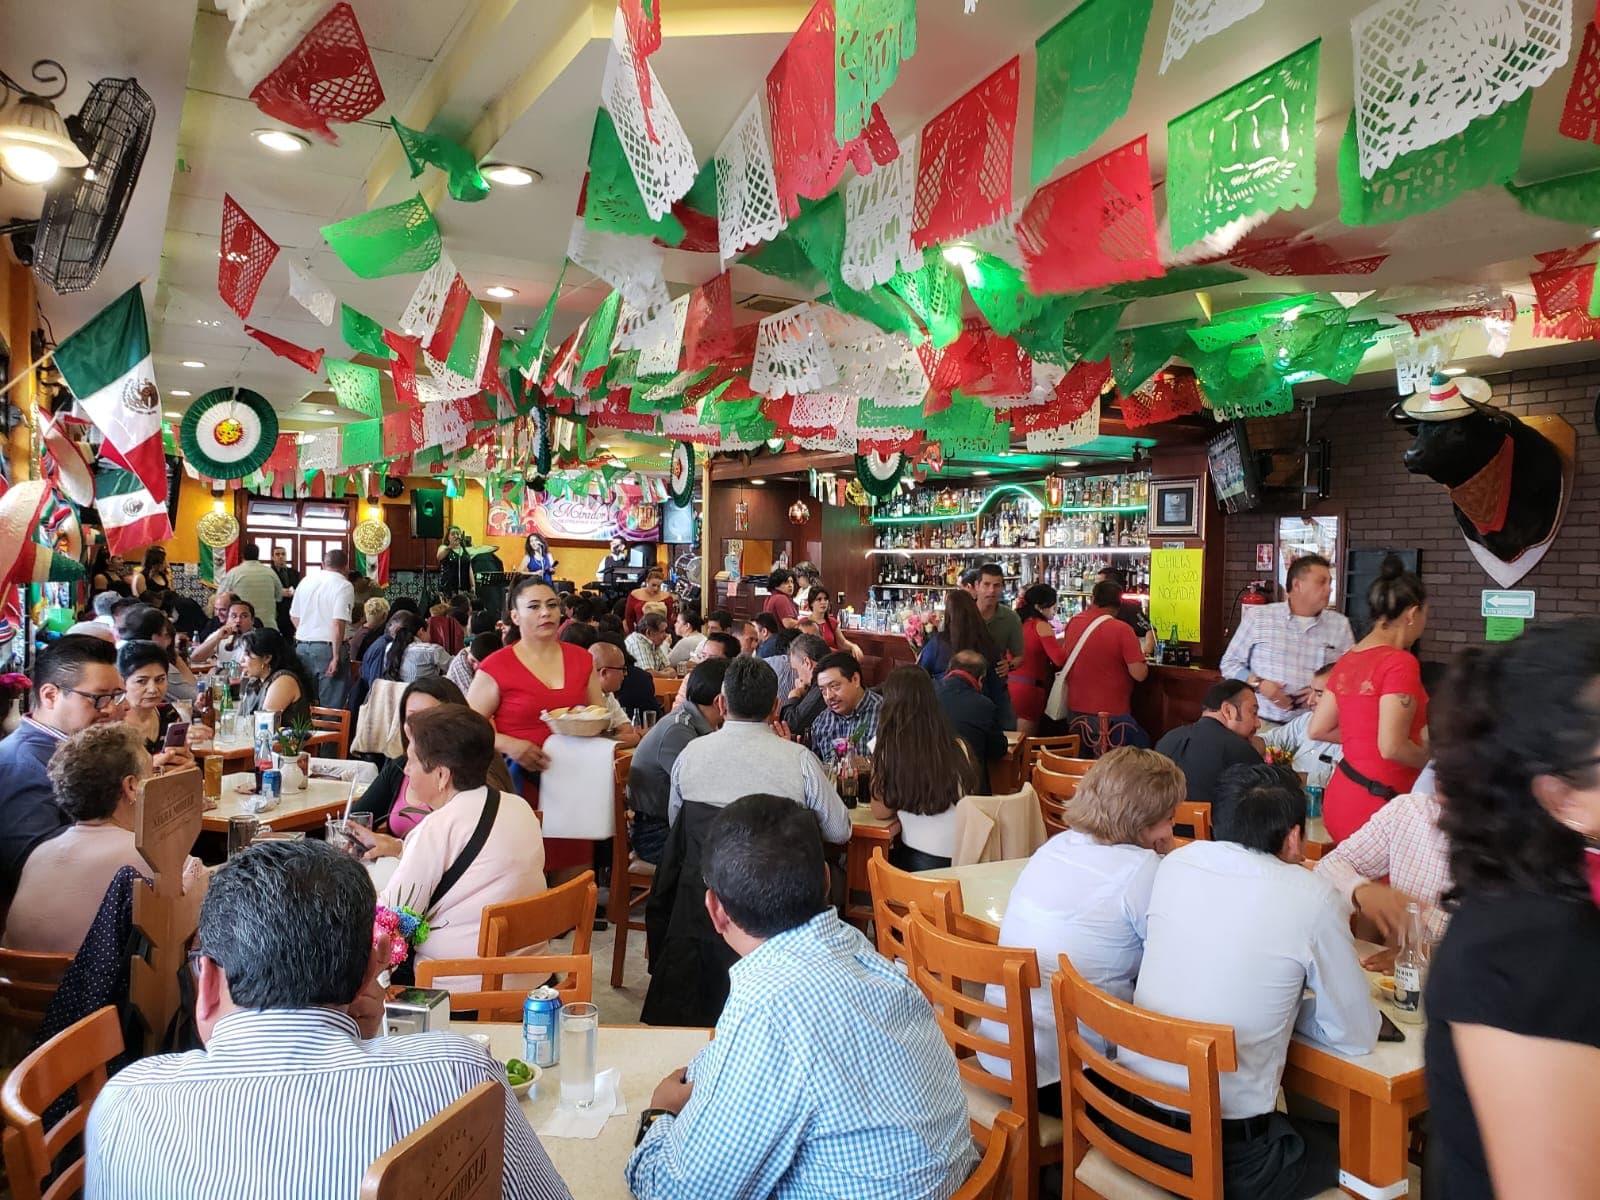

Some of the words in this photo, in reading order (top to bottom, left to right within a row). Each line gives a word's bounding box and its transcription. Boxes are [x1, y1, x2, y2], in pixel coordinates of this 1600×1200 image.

[552, 502, 606, 520] Mirador
[1158, 585, 1196, 601] NOGADA
[1169, 602, 1177, 616] Y
